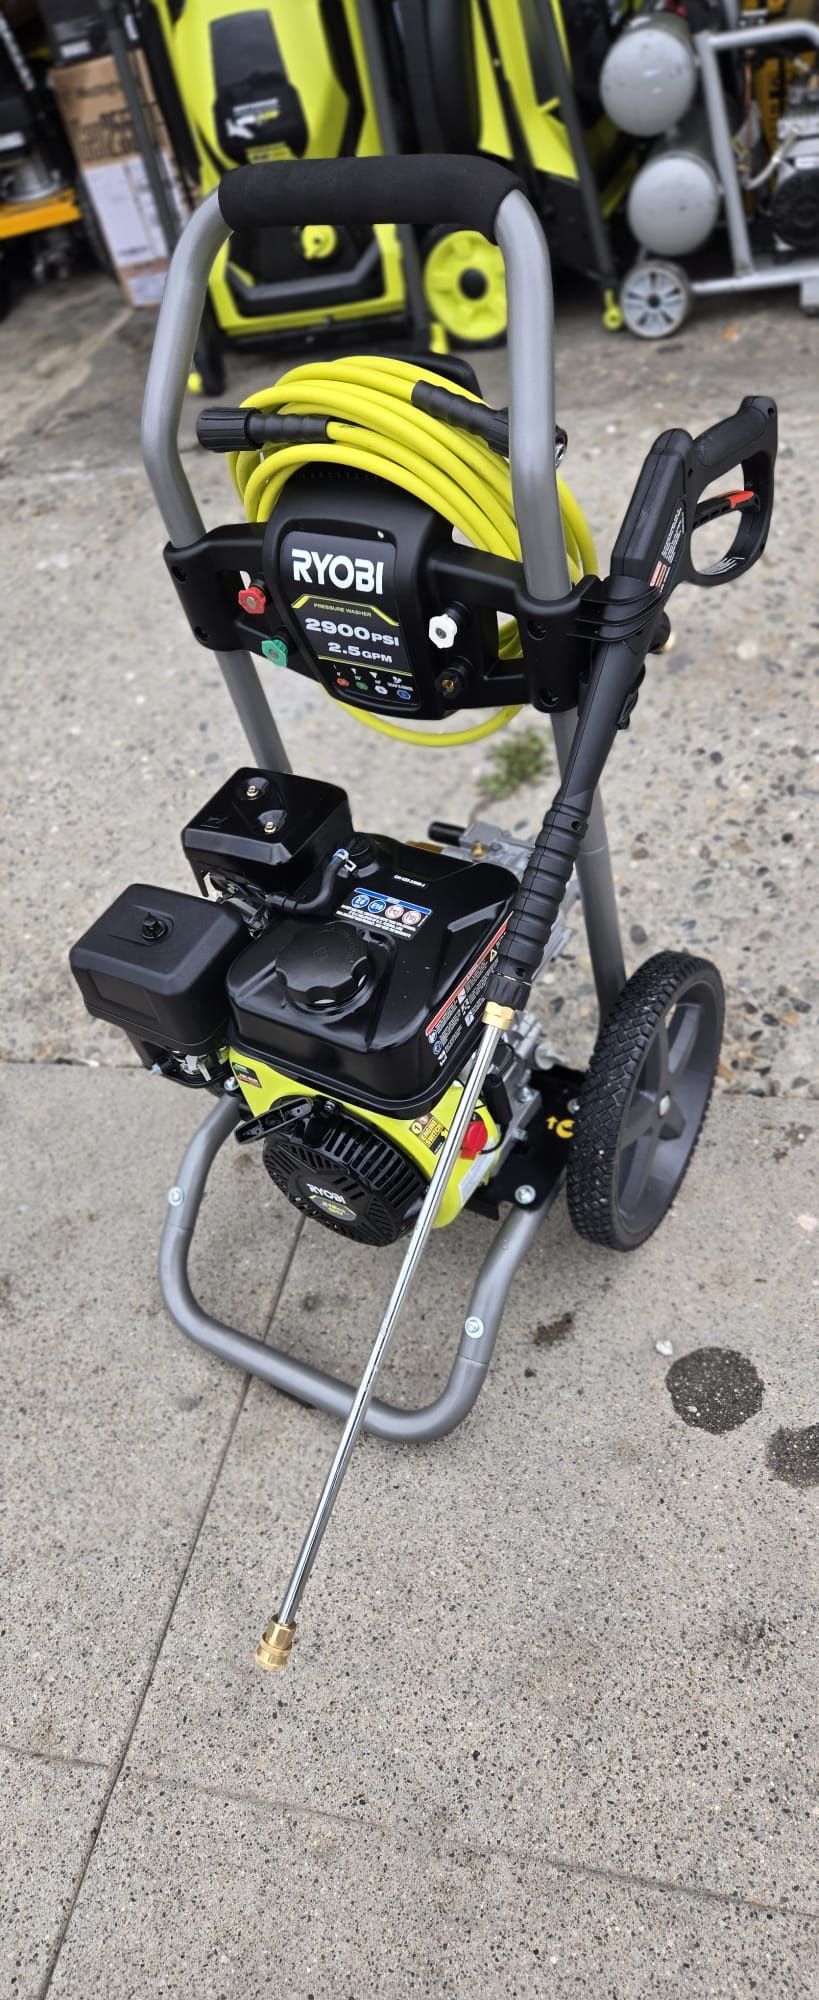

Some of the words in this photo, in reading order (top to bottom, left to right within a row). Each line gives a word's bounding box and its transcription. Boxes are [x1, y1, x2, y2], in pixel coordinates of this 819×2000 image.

[292, 549, 384, 594] RYOBI
[313, 602, 345, 613] PRESSURE
[345, 608, 372, 617] WASHER
[306, 1183, 346, 1205] RYOBI
